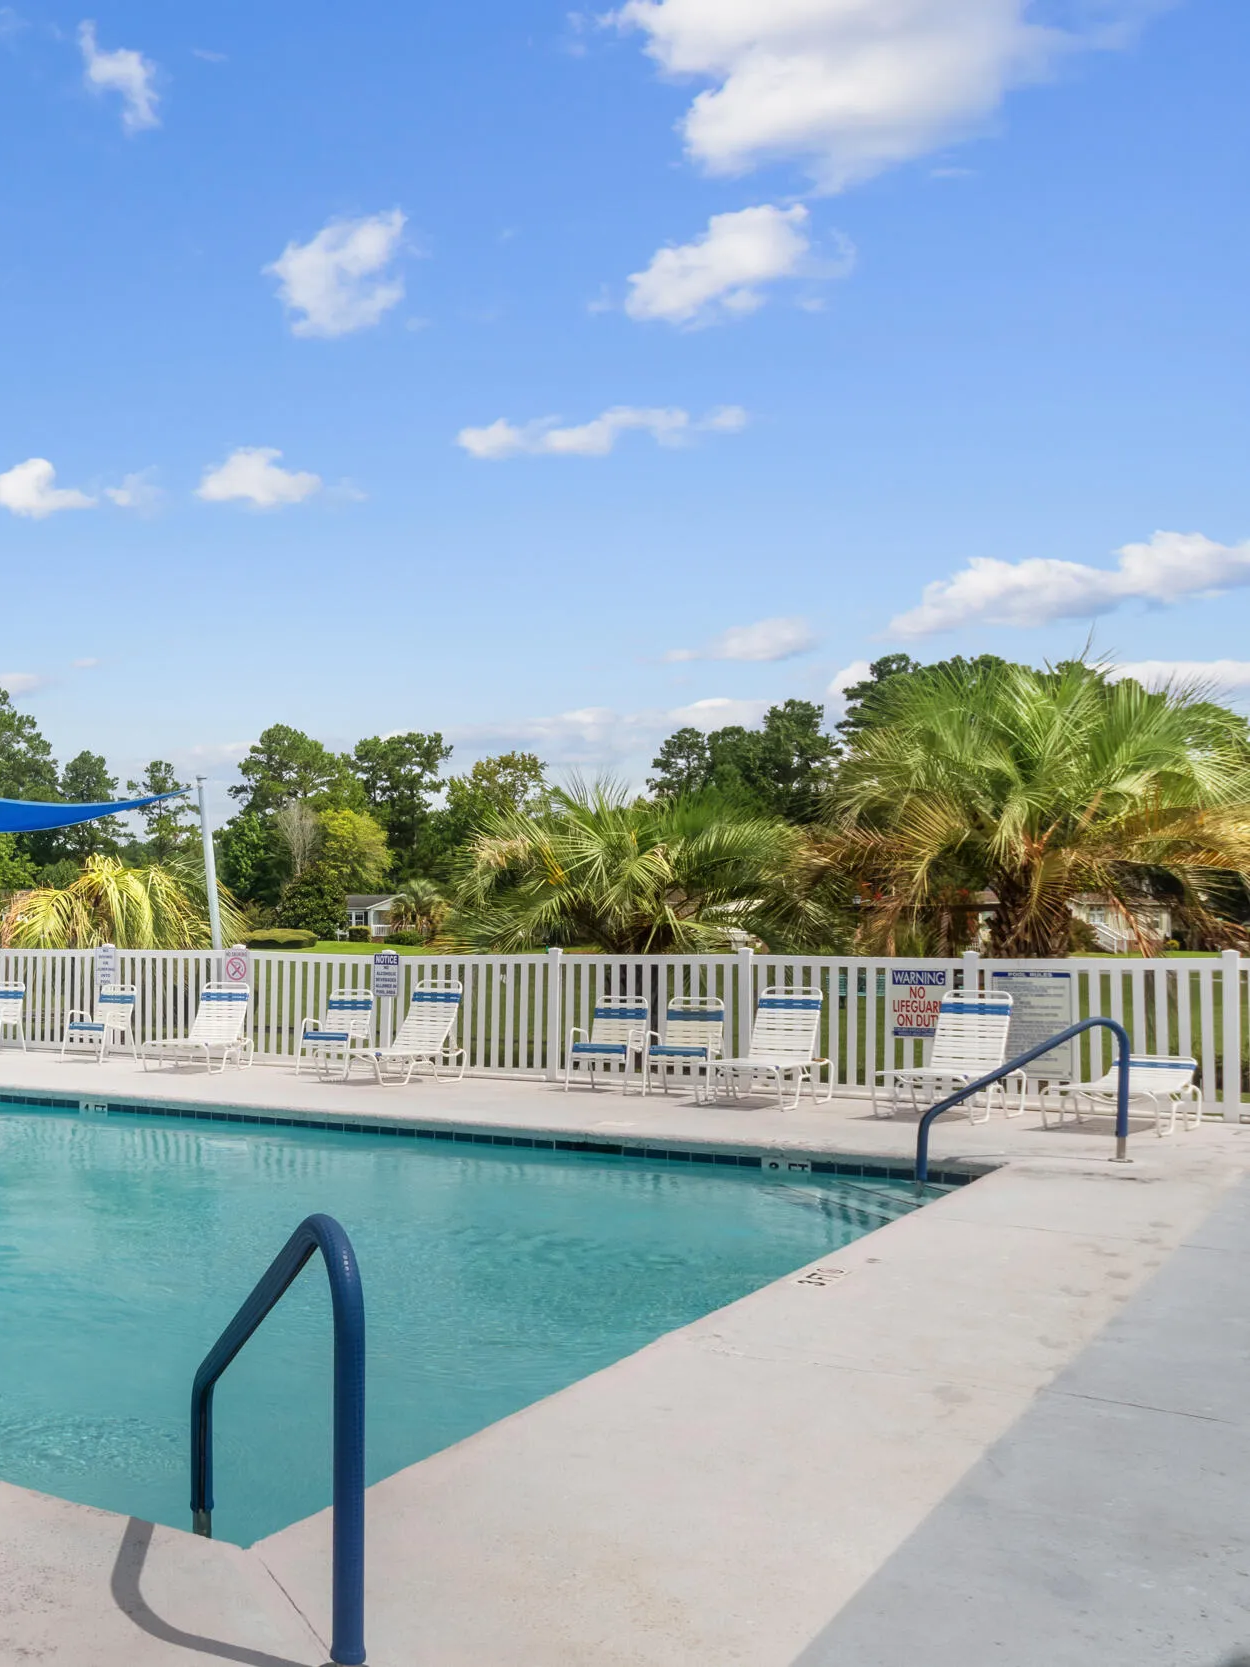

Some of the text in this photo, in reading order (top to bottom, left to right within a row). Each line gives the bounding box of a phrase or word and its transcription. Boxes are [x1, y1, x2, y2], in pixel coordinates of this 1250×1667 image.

[376, 956, 397, 964] NOTICE
[893, 971, 945, 985] WARNING
[909, 986, 926, 999] NO
[897, 1014, 913, 1027] ON
